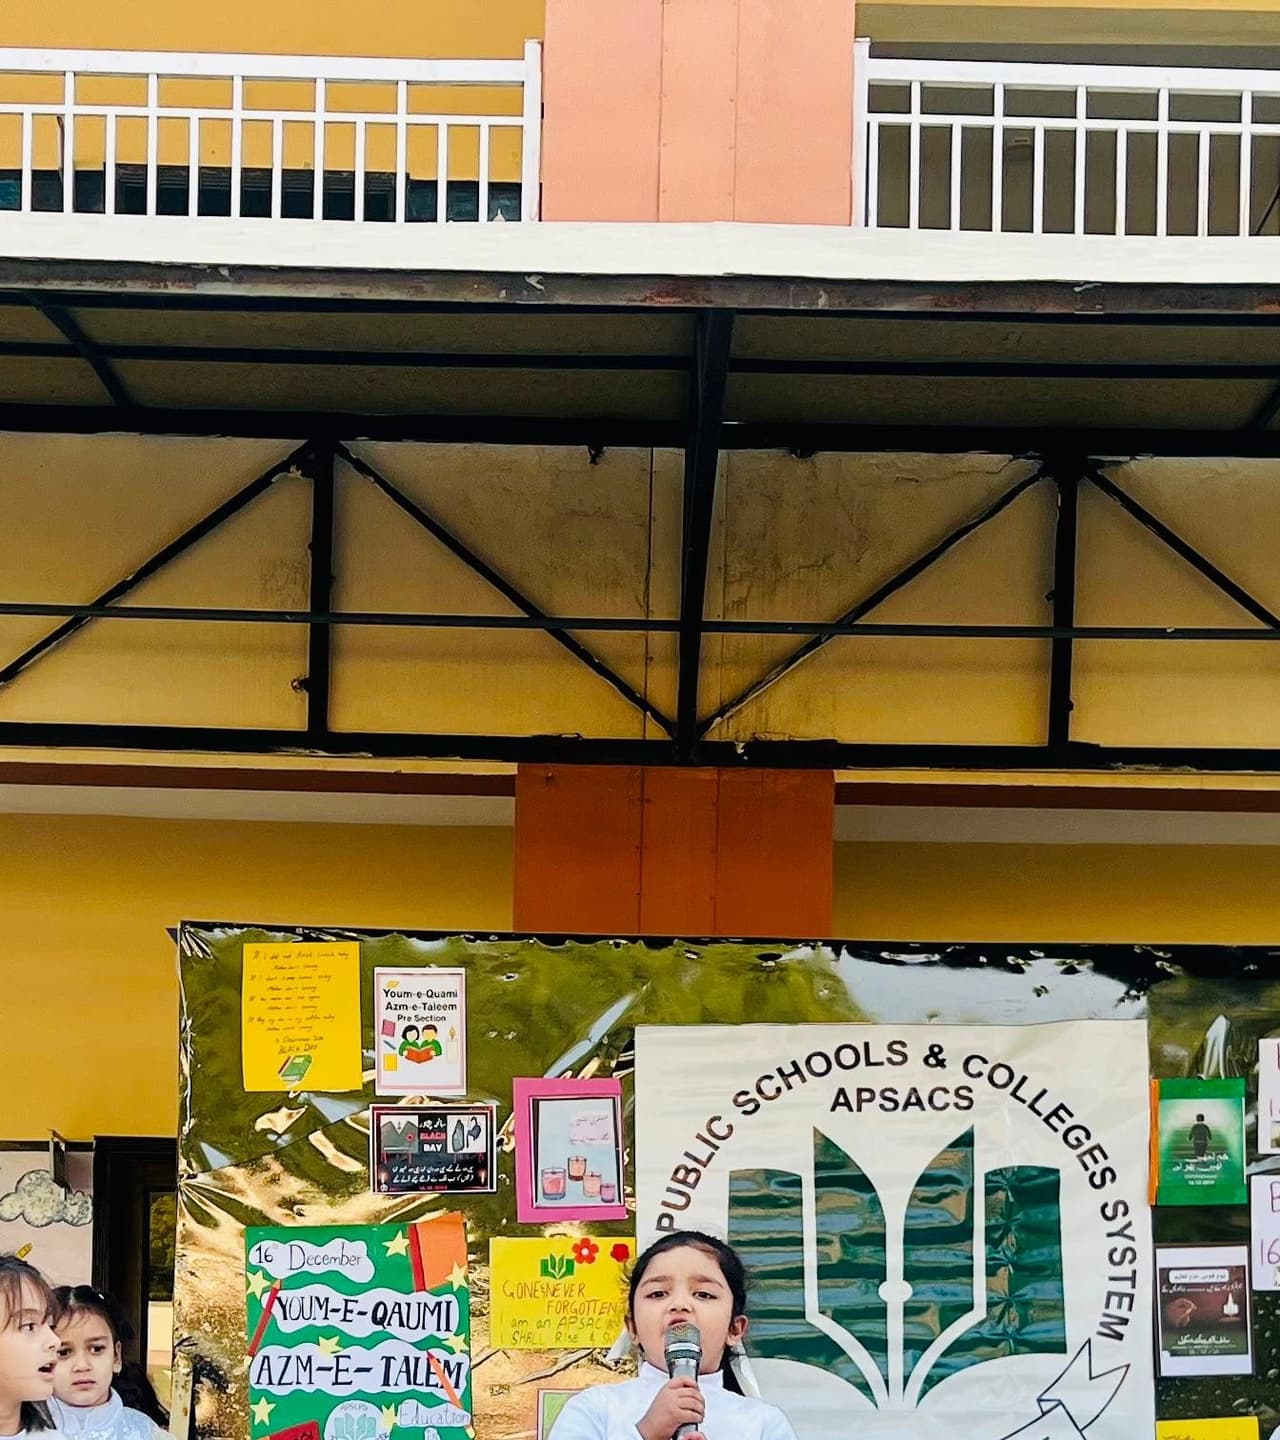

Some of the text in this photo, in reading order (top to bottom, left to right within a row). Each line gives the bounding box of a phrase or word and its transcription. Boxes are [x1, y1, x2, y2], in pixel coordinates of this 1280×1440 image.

[383, 988, 458, 999] Youm-e-Quami
[385, 1001, 457, 1011] Azm-e-Taleem
[397, 1014, 447, 1022] Pre Section
[829, 1085, 975, 1113] APSACS
[423, 1143, 443, 1152] DAY
[655, 1039, 1138, 1342] PUBLIC SCHOOLS & COLLEGES SYSTEM
[289, 1242, 363, 1271] December
[1260, 1238, 1280, 1266] 16
[275, 1295, 453, 1333] YOUM-E-QAUMI
